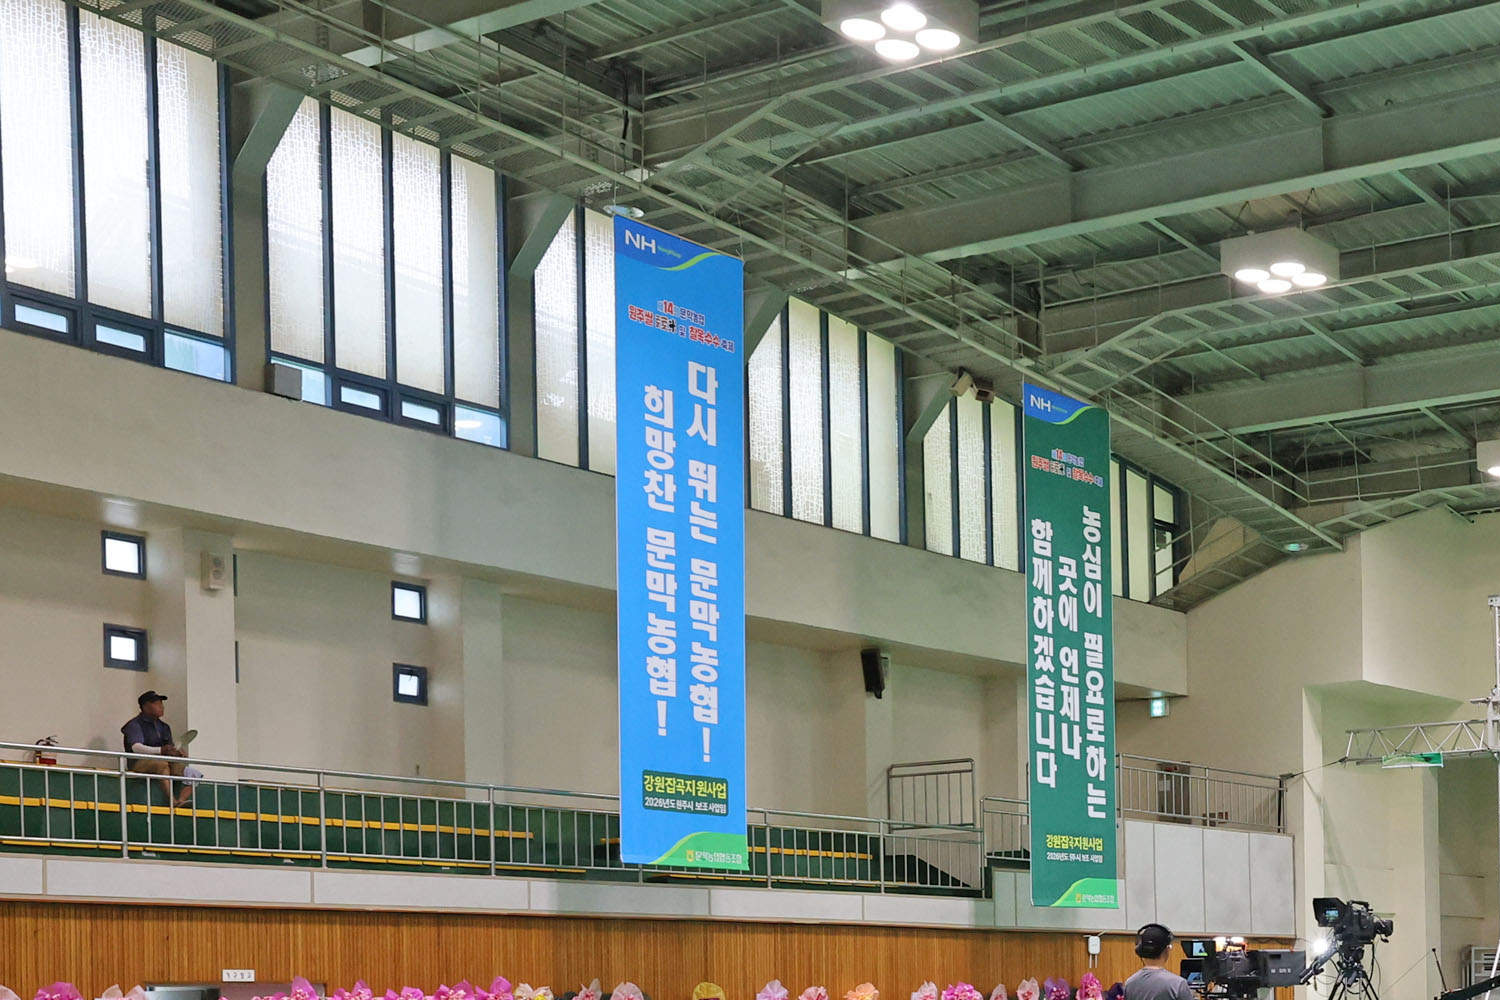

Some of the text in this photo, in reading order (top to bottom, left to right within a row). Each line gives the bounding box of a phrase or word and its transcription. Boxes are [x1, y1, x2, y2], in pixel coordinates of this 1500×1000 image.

[624, 229, 656, 254] NH
[628, 304, 654, 326] 원주쌀
[689, 326, 720, 348] 찰옥수수
[1030, 394, 1051, 412] NH
[643, 384, 677, 736] 희망찬 문막농협!
[687, 361, 720, 762] 다시 뛰는 문막농협!
[1082, 505, 1103, 619] 농심이
[1031, 518, 1058, 788] 함께하겠습니다
[1058, 556, 1082, 760] 곳에 언제나
[644, 775, 727, 800] 강원잡곡지원사업
[1046, 834, 1104, 852] 강원잡곡지원사업
